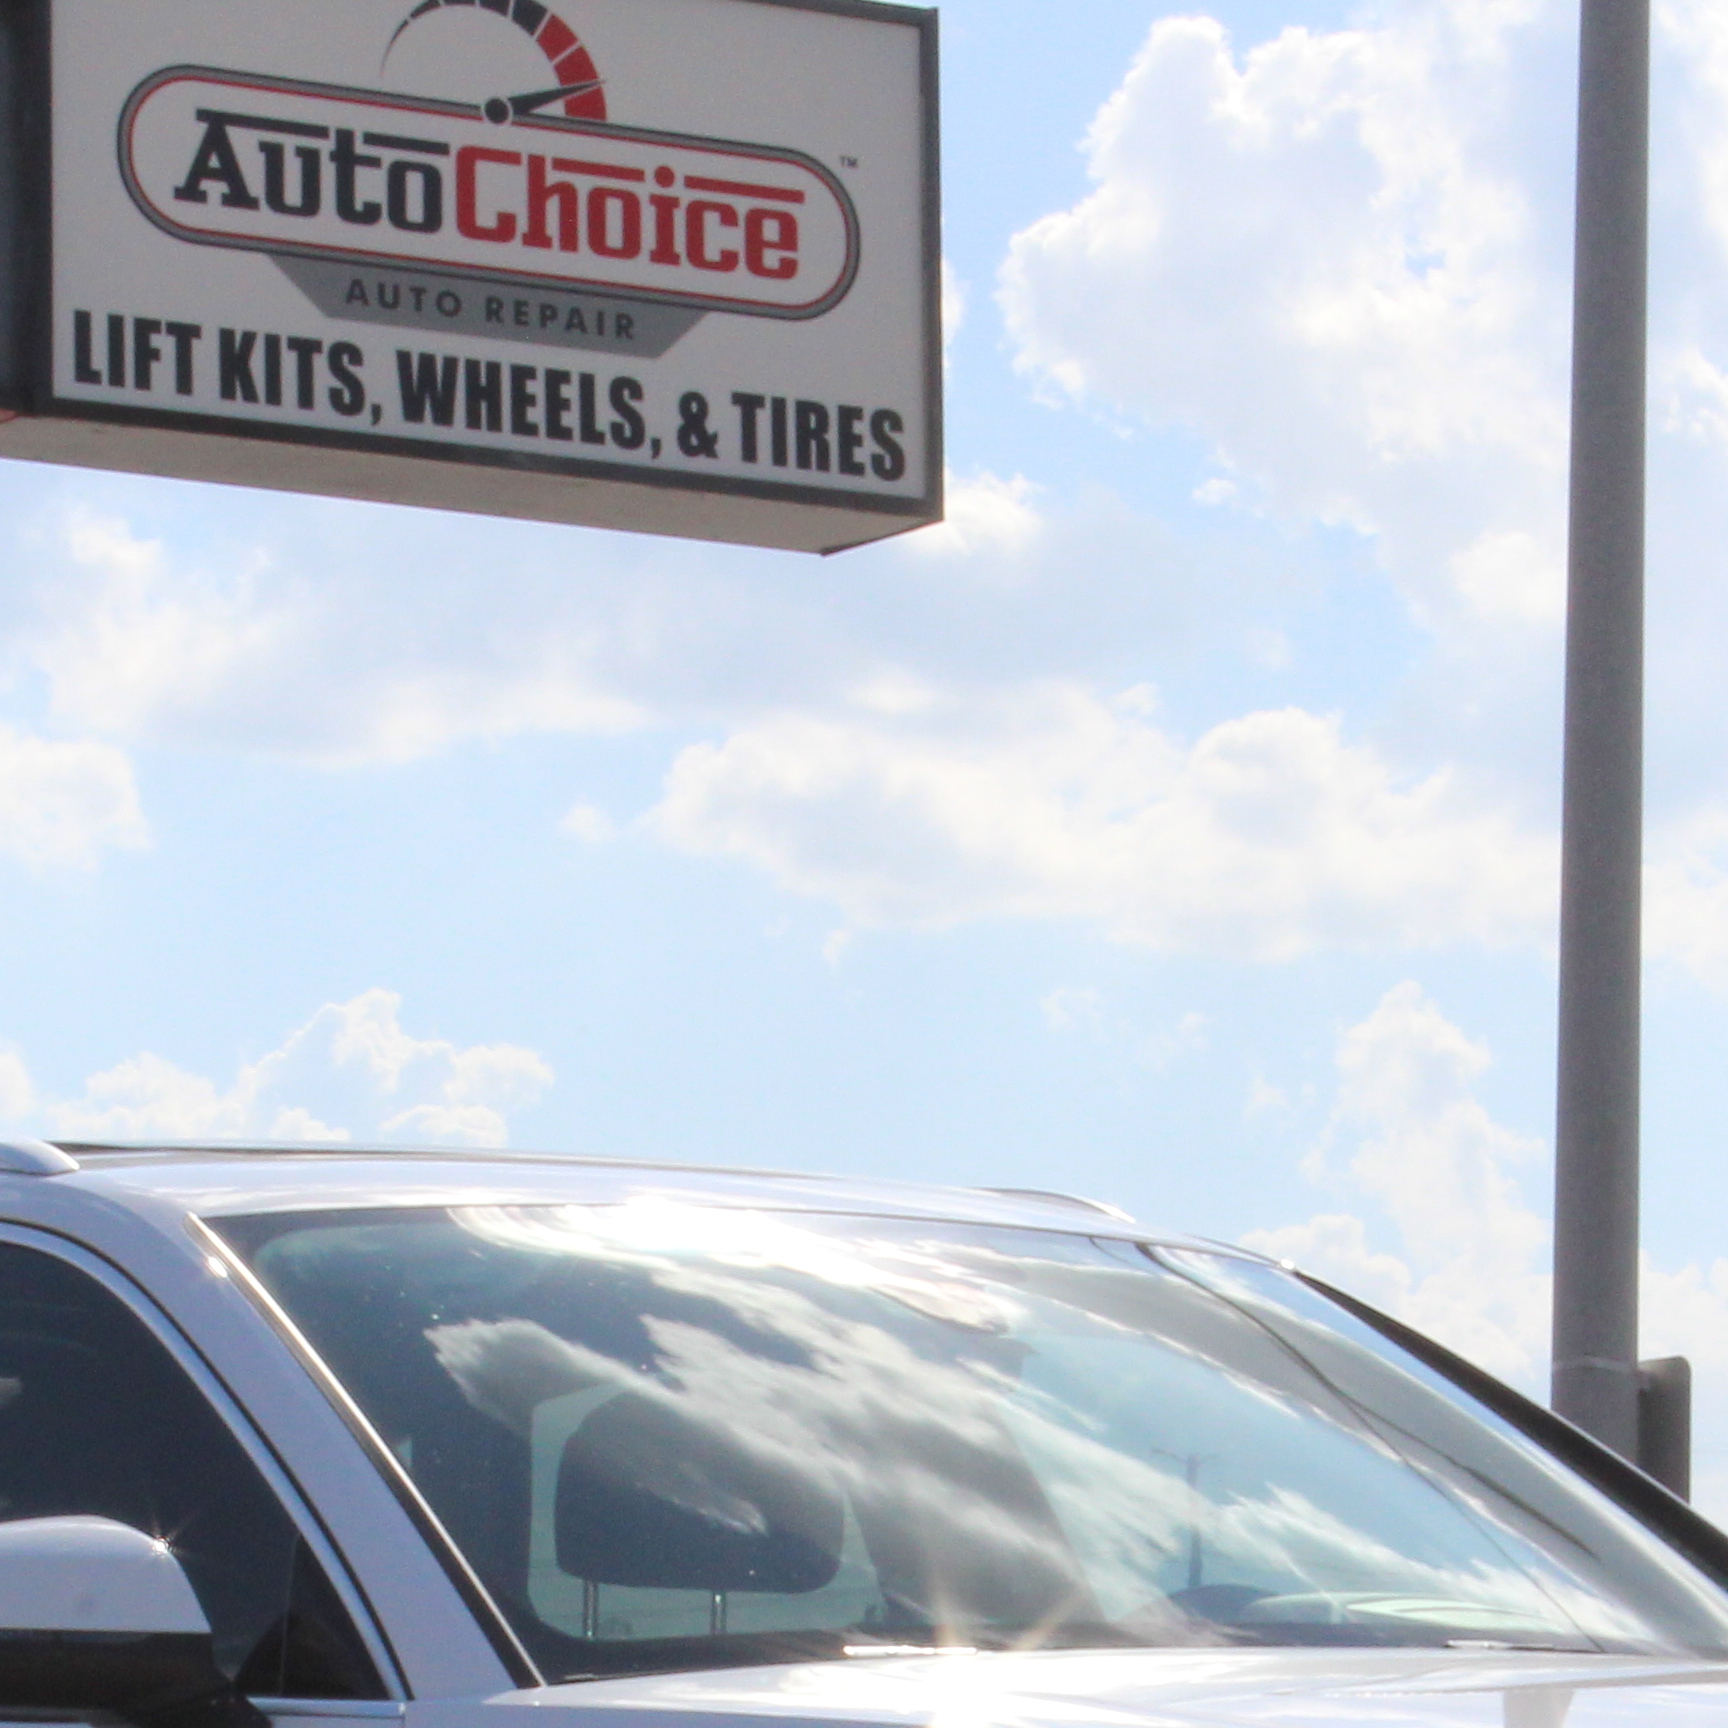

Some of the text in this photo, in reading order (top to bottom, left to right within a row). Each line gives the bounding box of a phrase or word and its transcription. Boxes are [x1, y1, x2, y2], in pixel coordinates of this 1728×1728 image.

[345, 279, 635, 340] AUTO REPAIR
[74, 309, 906, 482] LIFT KITS, WHEELS, & TIRES
